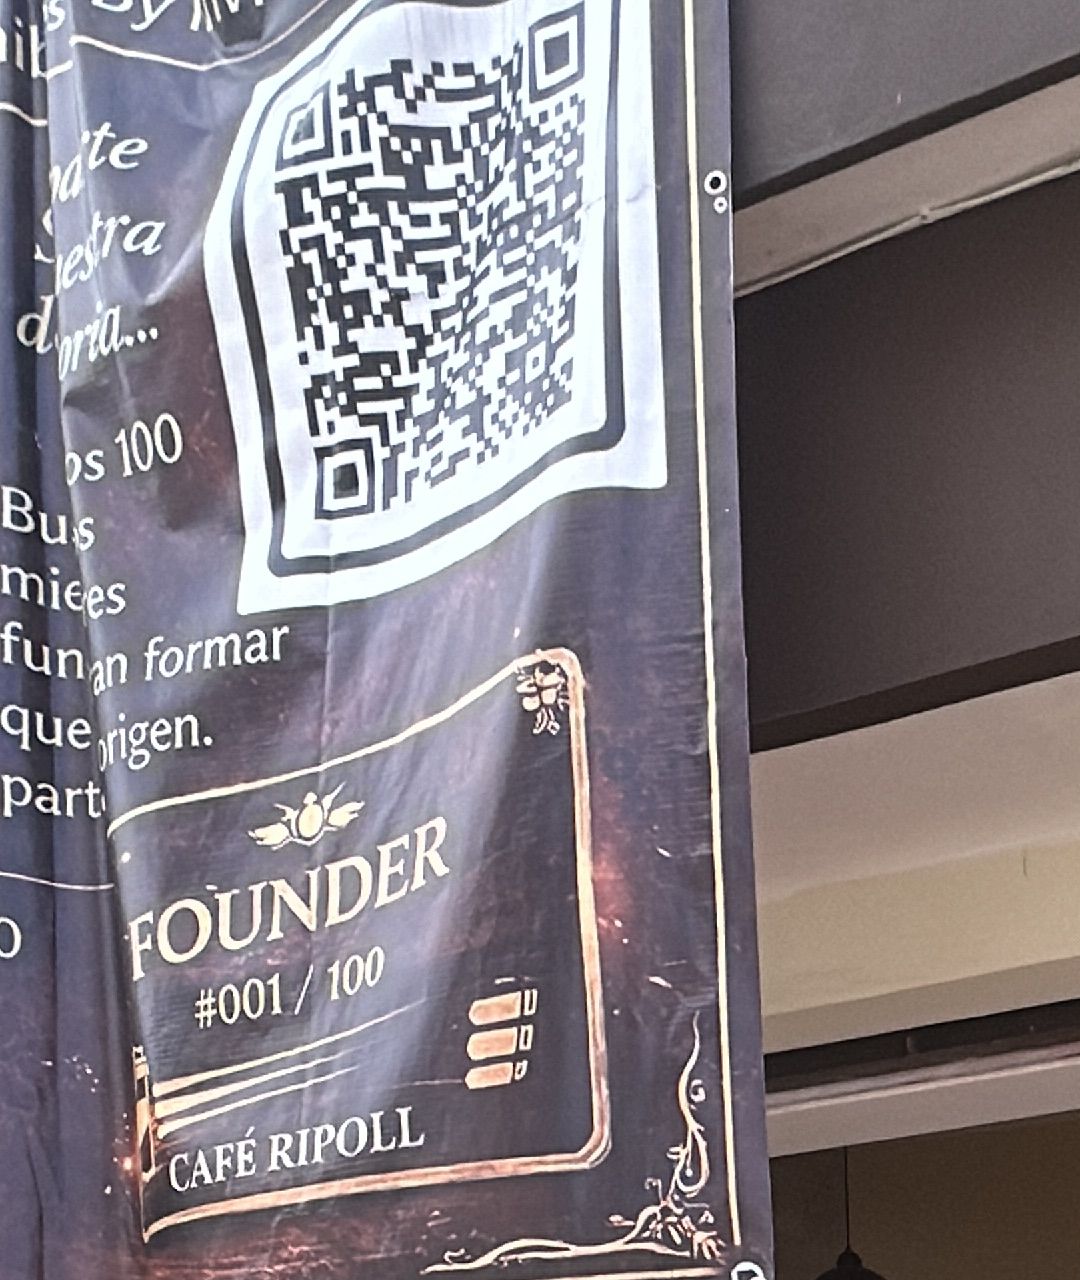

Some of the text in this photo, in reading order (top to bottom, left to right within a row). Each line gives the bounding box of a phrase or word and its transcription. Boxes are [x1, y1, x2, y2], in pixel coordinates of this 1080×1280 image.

[114, 412, 183, 478] 100
[143, 624, 290, 682] formar
[0, 703, 92, 752] que
[127, 816, 451, 983] FOUNDER
[194, 972, 284, 1030] #001
[326, 945, 386, 1001] 100
[168, 1105, 426, 1193] CAFÉ RIPOLL
